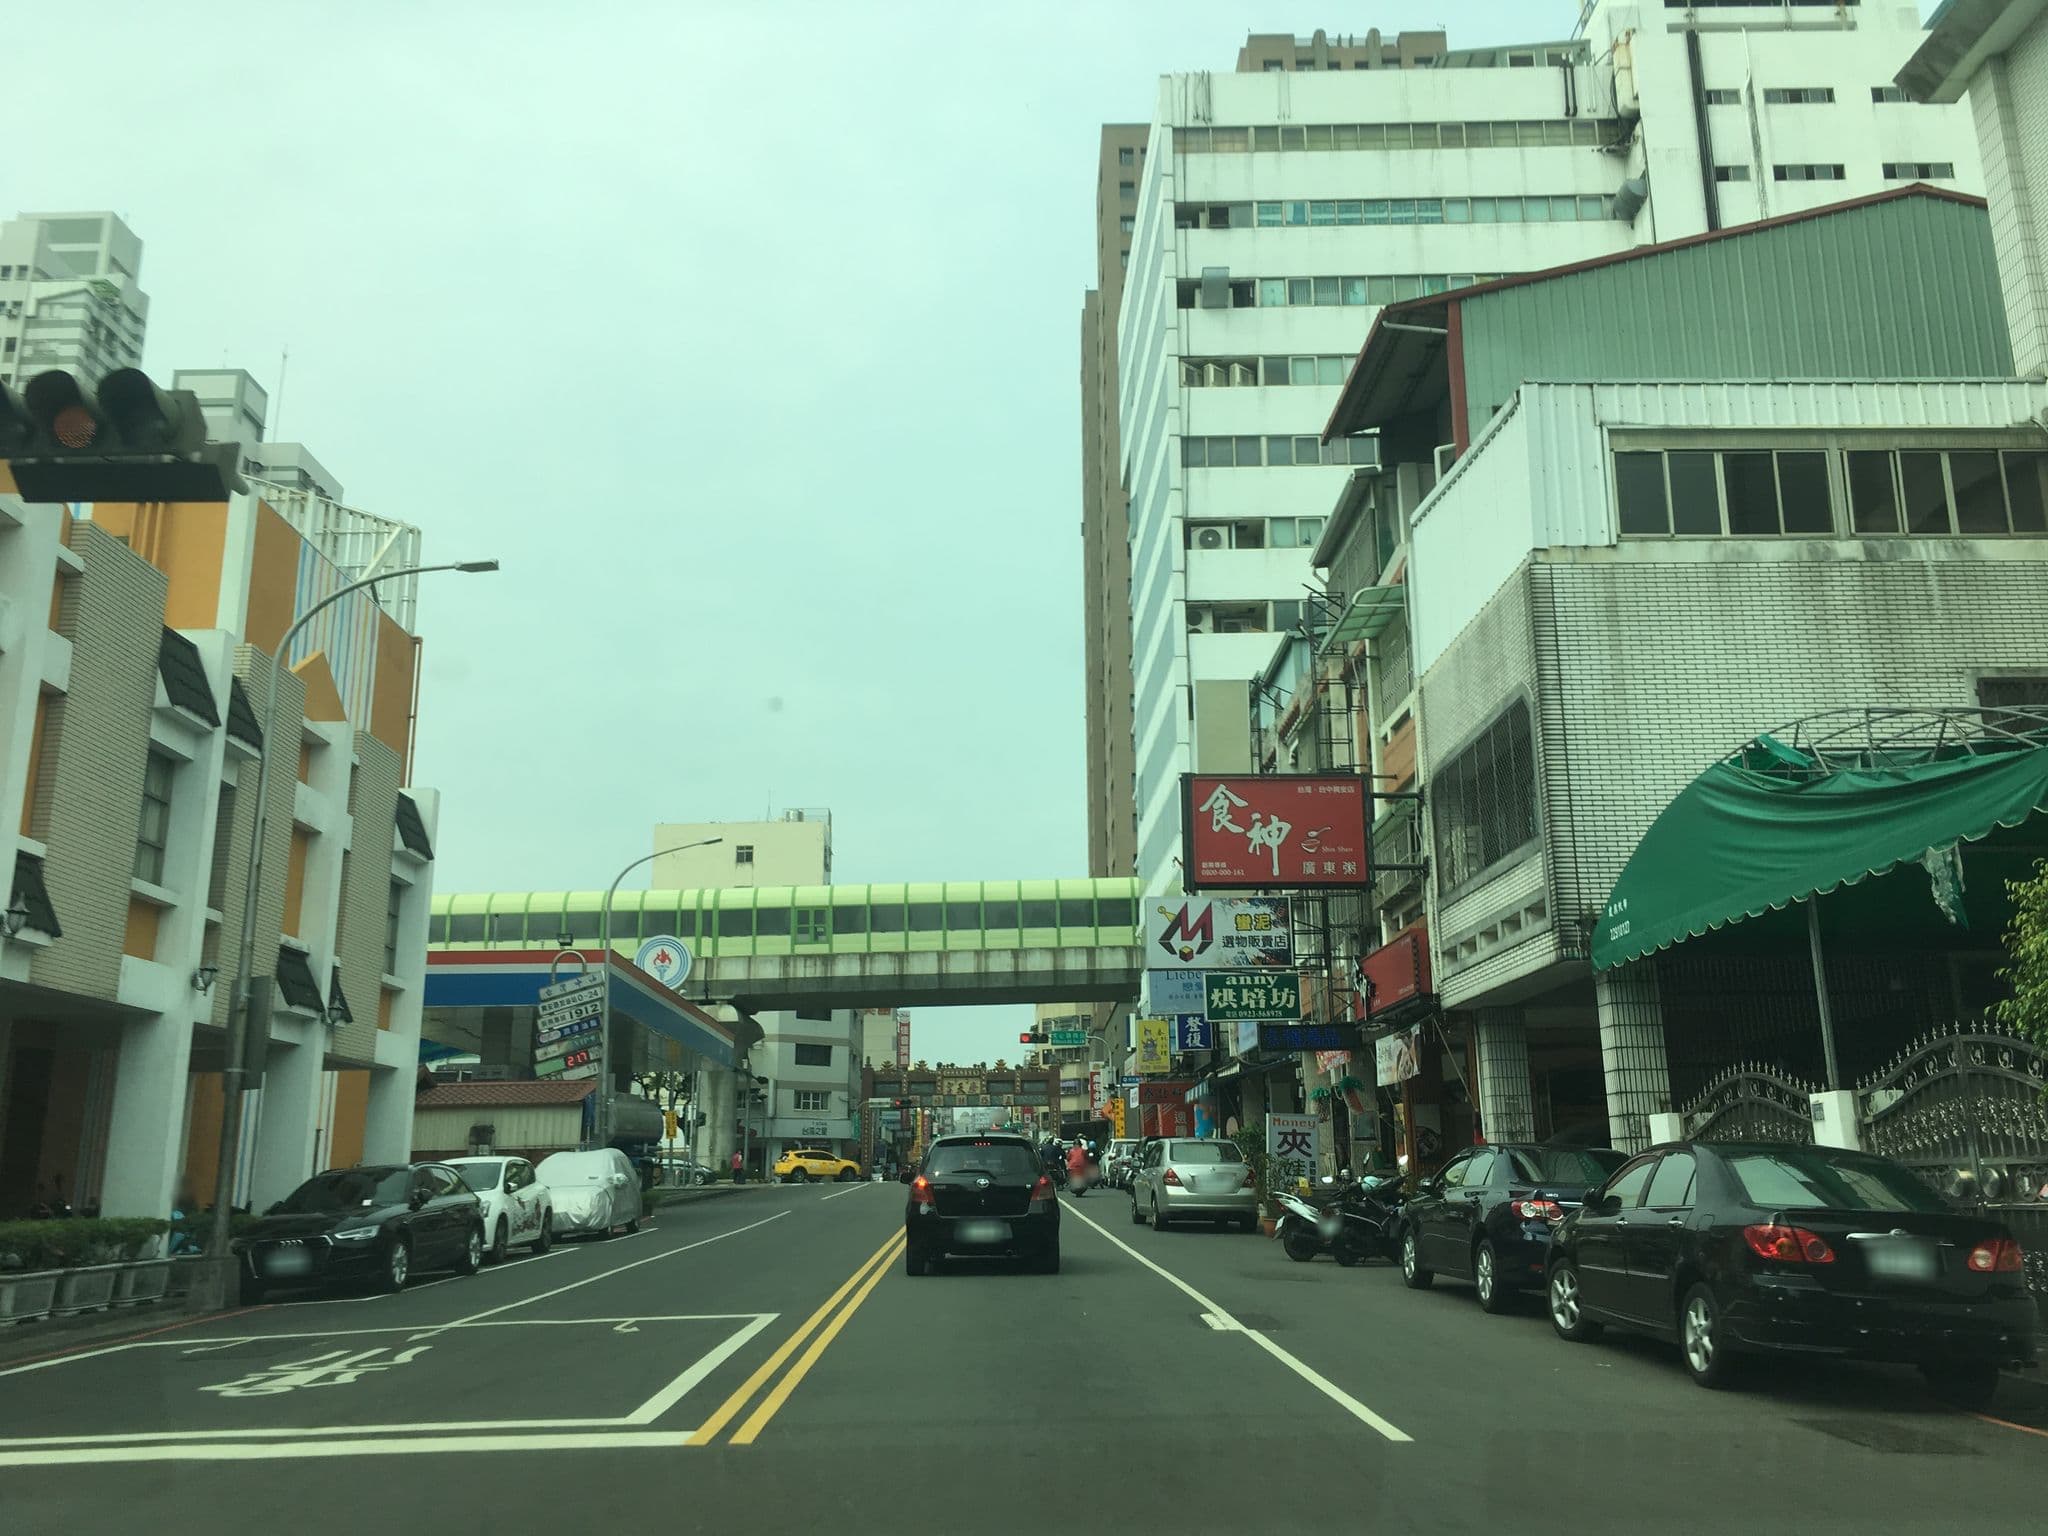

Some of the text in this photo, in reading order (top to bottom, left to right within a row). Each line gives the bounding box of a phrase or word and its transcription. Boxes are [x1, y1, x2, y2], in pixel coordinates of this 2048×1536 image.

[1199, 783, 1292, 877] 食神
[1302, 861, 1358, 875] 廣東粥
[1222, 935, 1287, 948] 選物販賣店
[1225, 975, 1278, 988] anny
[1185, 1016, 1206, 1048] 整復
[1273, 1117, 1316, 1129] Money
